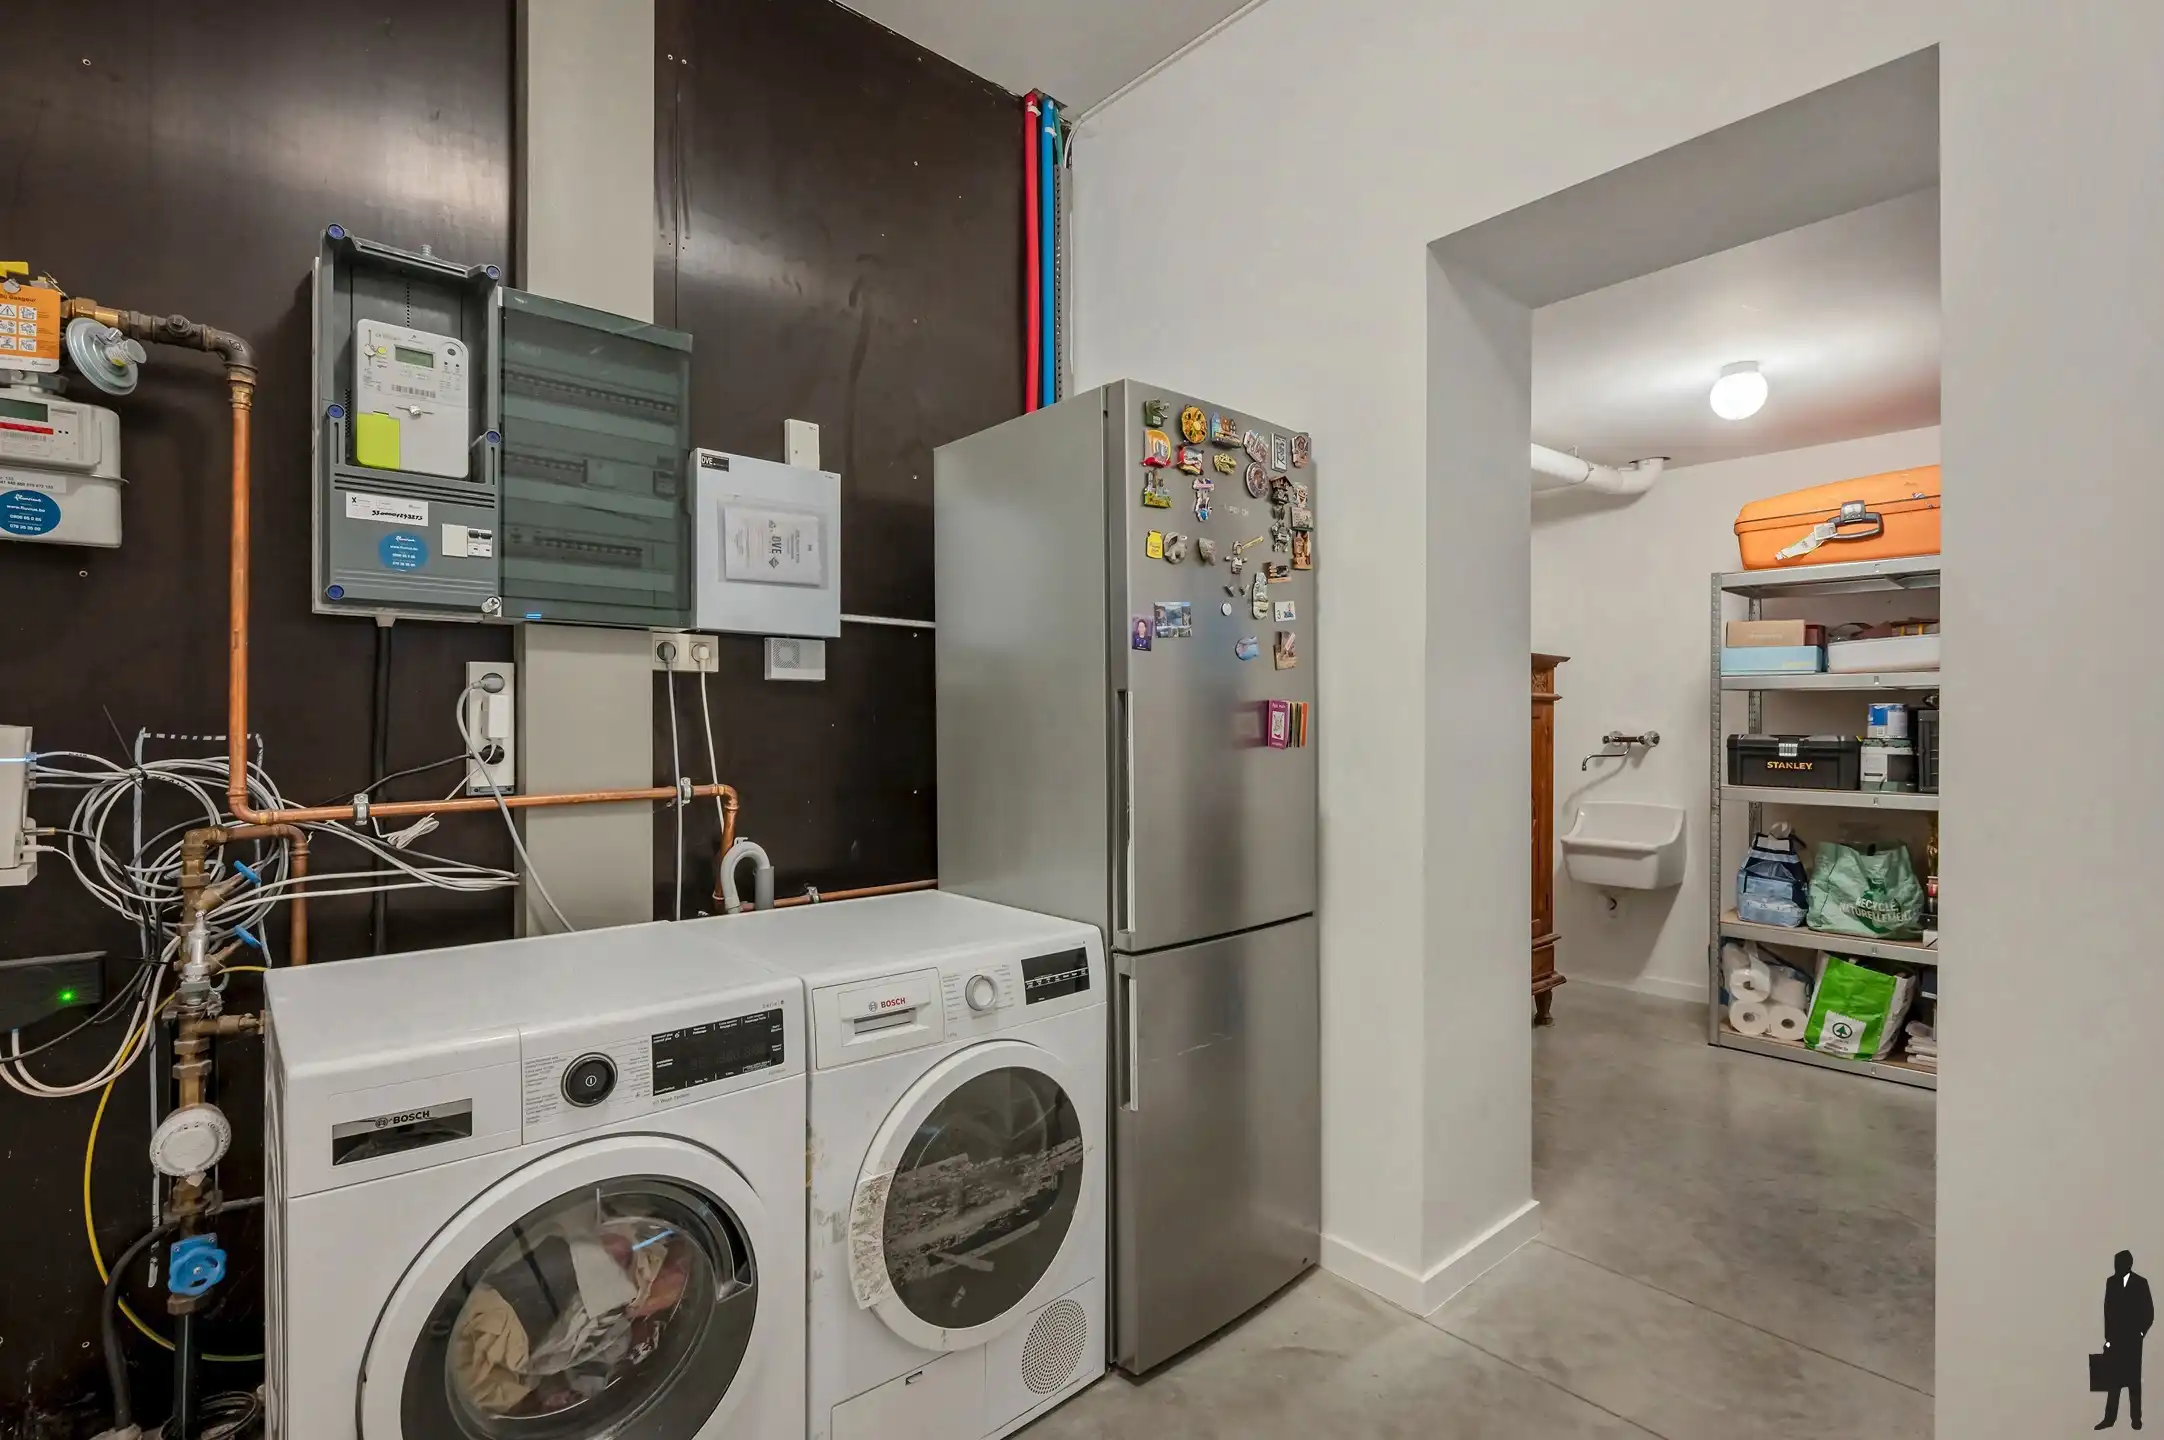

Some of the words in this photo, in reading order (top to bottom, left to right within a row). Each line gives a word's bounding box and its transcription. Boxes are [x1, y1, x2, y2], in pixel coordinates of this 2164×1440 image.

[1767, 761, 1812, 770] STANLEY
[880, 997, 906, 1009] BOSCH
[393, 1110, 430, 1125] BOSCH
